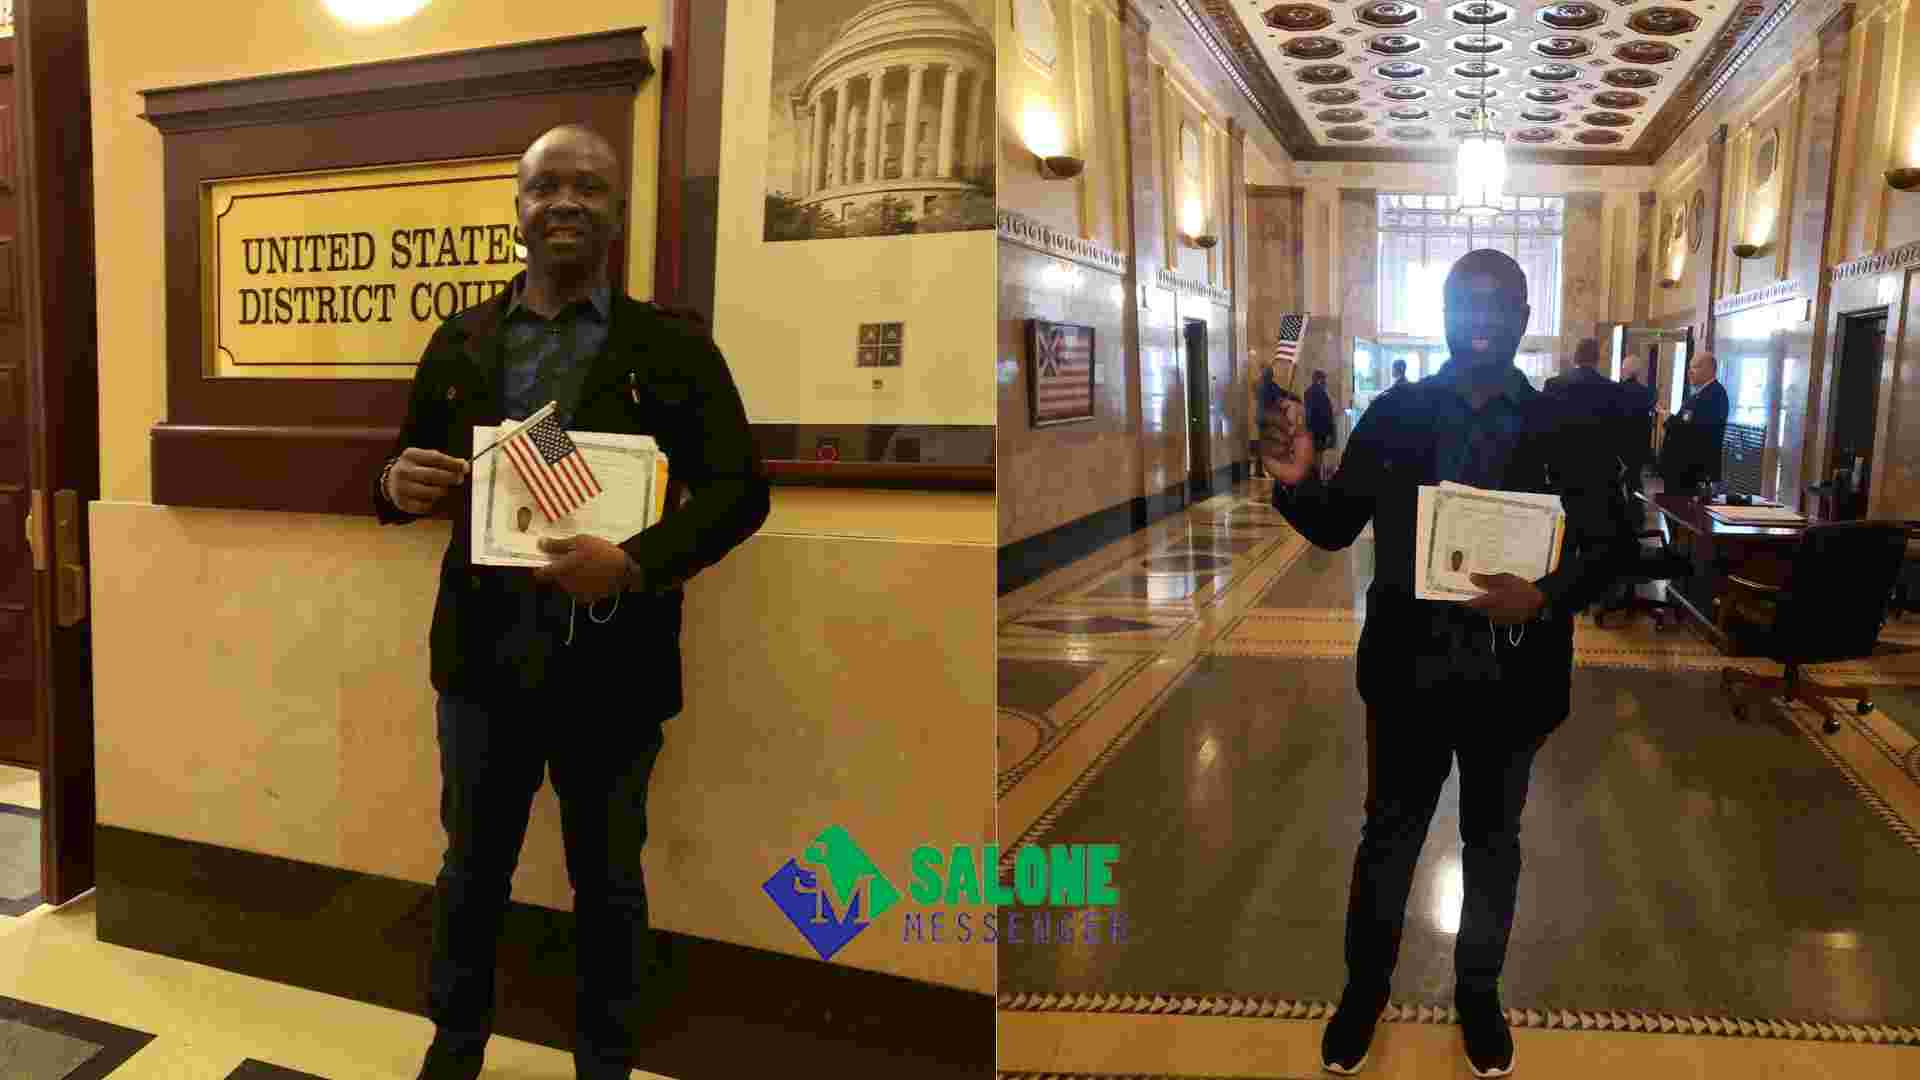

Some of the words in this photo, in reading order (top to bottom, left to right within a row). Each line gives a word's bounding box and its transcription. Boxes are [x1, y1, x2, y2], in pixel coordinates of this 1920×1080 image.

[240, 231, 376, 275] UNITED
[391, 224, 528, 270] STATES
[238, 282, 396, 326] DISTRICT
